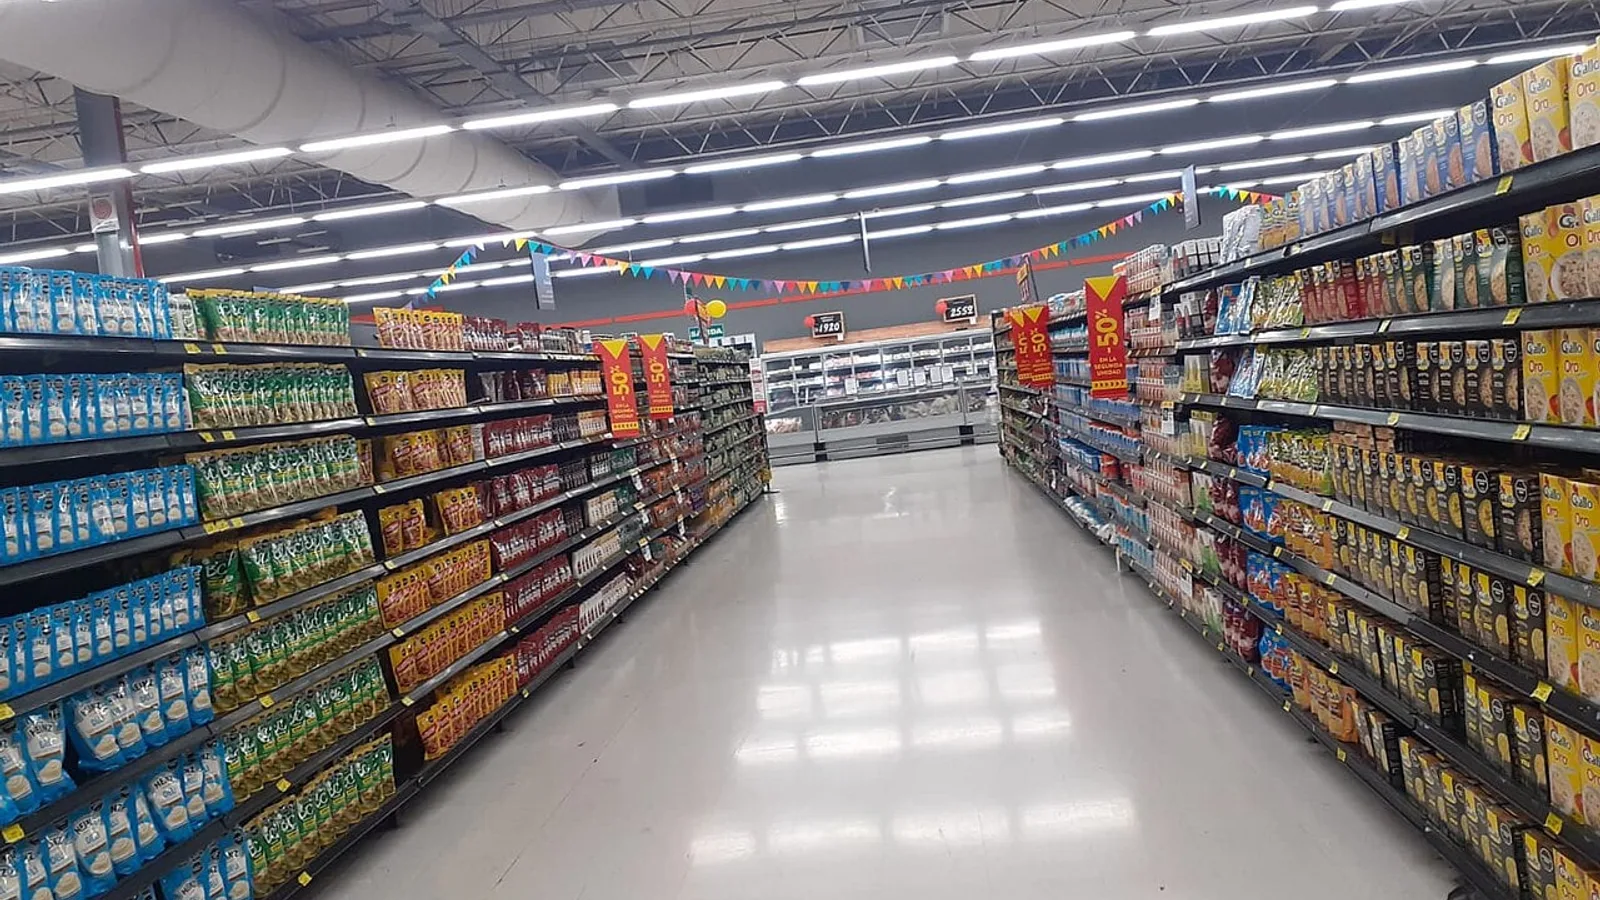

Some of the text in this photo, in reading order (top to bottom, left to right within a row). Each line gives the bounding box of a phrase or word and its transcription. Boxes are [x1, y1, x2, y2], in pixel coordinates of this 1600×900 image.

[1573, 59, 1600, 77] Gallo
[1528, 79, 1552, 94] Gallo
[1577, 82, 1595, 97] Oro
[1533, 98, 1548, 112] Oro
[1499, 113, 1514, 126] Oro
[1523, 225, 1543, 238] Gallo
[1527, 243, 1541, 256] Oro
[1094, 308, 1120, 354] -50%
[1030, 327, 1048, 357] -50%
[1527, 341, 1547, 354] Gallo
[1561, 340, 1583, 354] Gallo
[647, 356, 667, 388] -50%
[1528, 359, 1544, 373] Oro
[1563, 359, 1579, 373] Oro
[610, 364, 631, 402] -50%
[1543, 485, 1562, 500] Gallo
[1571, 493, 1593, 509] Gallo
[1545, 504, 1559, 517] Oro
[1575, 512, 1590, 527] Oro
[1551, 729, 1571, 750] Gallo
[1553, 748, 1568, 764] Oro
